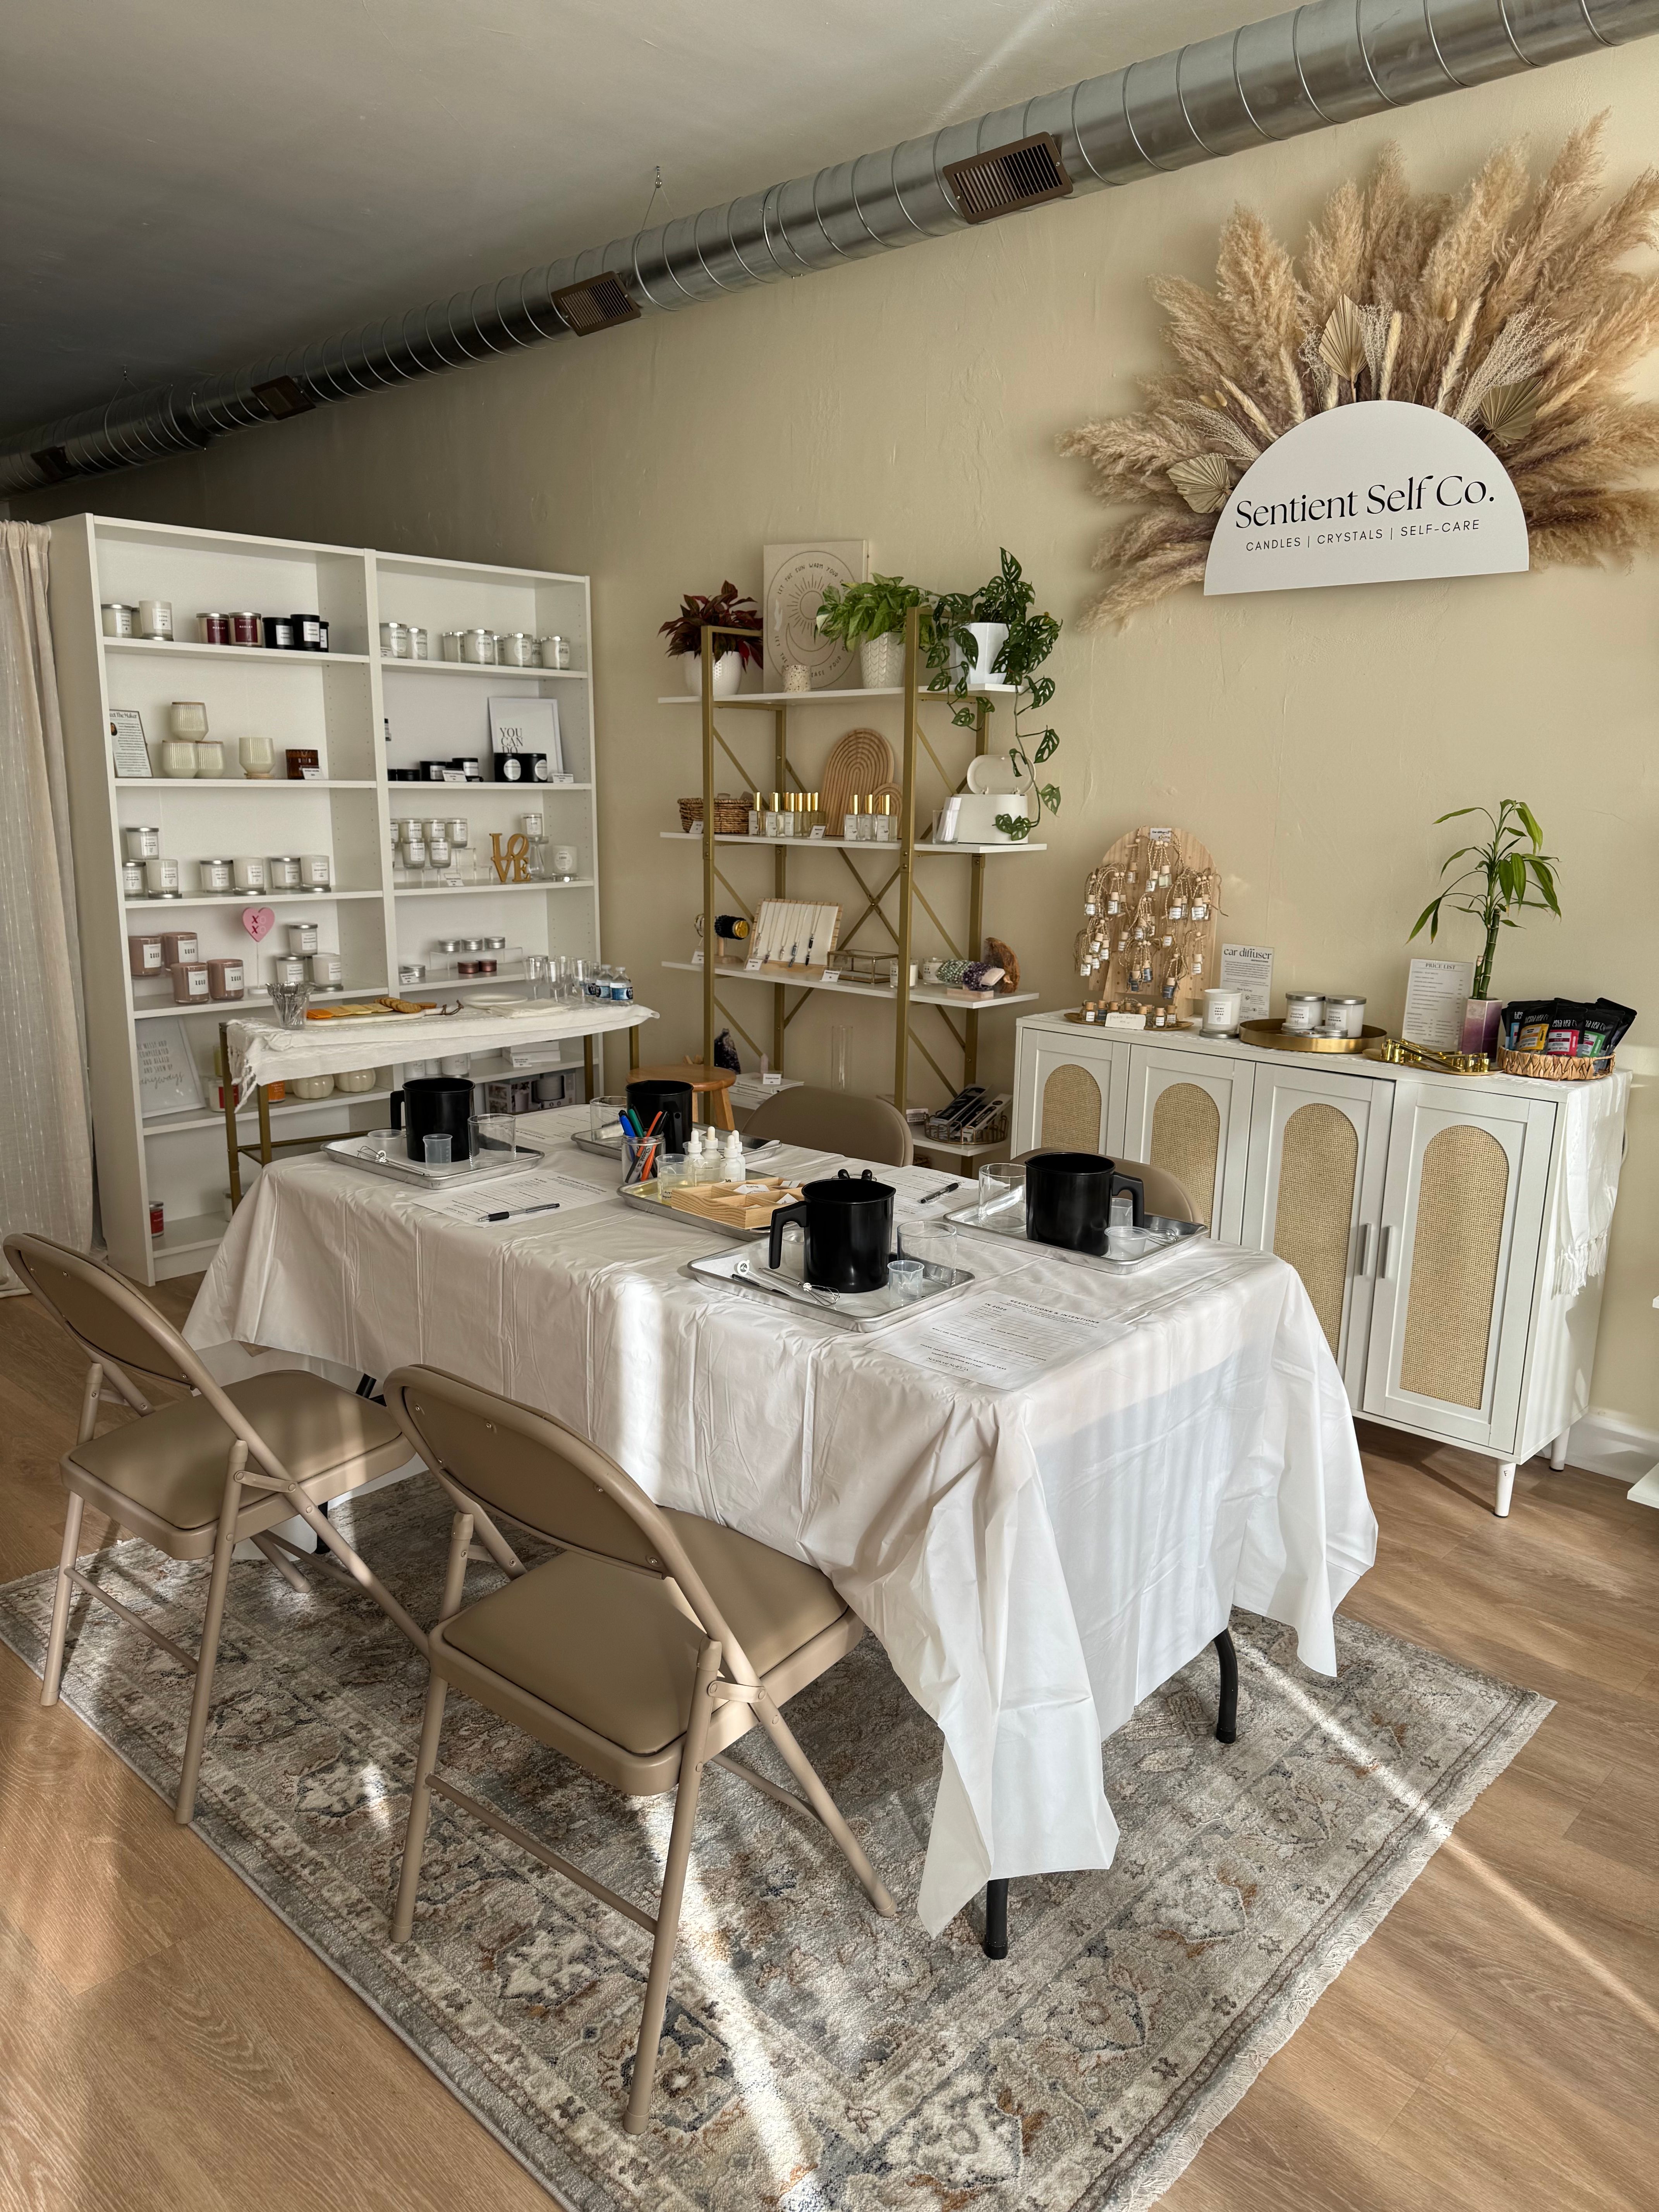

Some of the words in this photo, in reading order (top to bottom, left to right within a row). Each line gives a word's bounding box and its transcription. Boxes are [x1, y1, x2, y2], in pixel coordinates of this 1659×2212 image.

[1236, 491, 1358, 528] Sentient
[1367, 475, 1434, 514] Self
[1436, 476, 1494, 506] Co.
[1246, 537, 1301, 551] CANDLES
[1317, 529, 1382, 544] CRYSTALS
[1400, 519, 1480, 536] SELF-CARE
[785, 573, 793, 581] THE
[795, 565, 805, 573] SUN
[826, 567, 838, 577] YOUR
[829, 656, 841, 670] YOUR
[500, 727, 522, 737] YOU
[501, 737, 523, 747] CAN
[1239, 948, 1272, 959] diffuser
[1010, 1300, 1052, 1313] RESOLUTIONS
[1060, 1314, 1100, 1324] INTENTIONS
